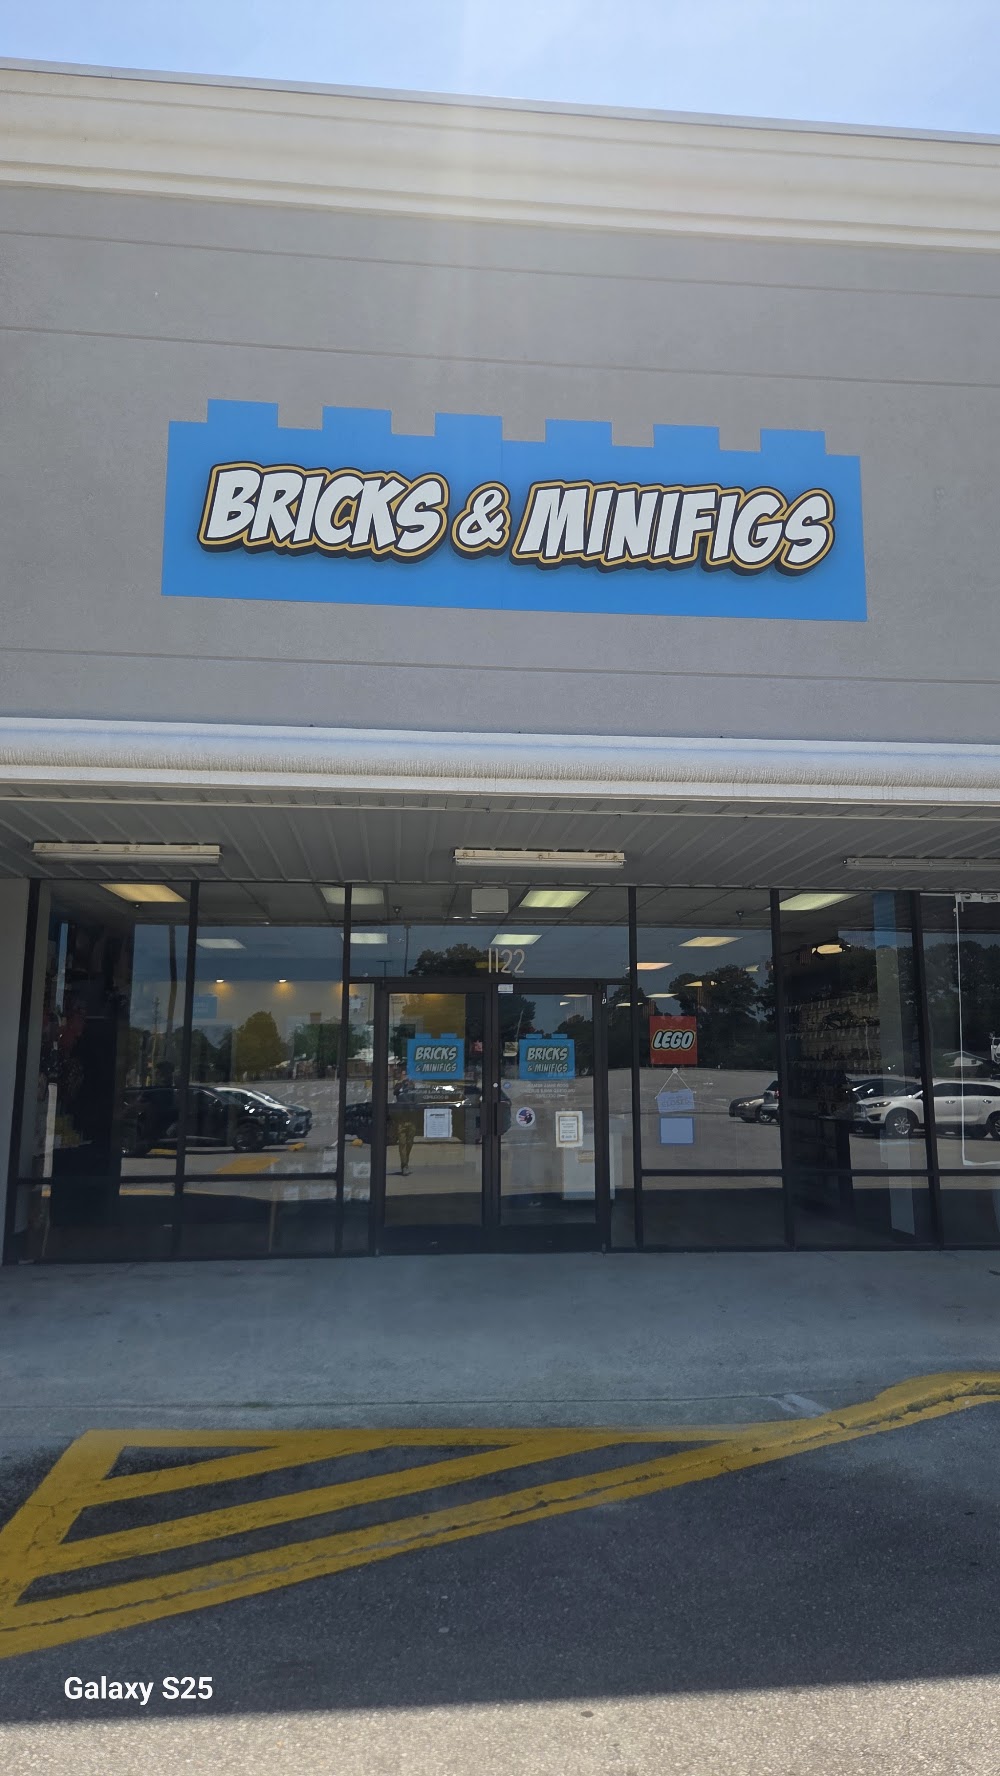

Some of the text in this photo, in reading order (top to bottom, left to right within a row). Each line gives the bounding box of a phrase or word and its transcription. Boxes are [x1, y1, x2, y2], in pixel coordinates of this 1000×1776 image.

[202, 465, 832, 567] BRICKS & MINIFIGS
[488, 948, 525, 973] 1122
[652, 1030, 695, 1050] LEGO
[415, 1046, 457, 1060] BRICKS
[527, 1047, 568, 1060] BRICKS
[415, 1063, 457, 1072] & MINIFIGS
[534, 1063, 568, 1072] MINIFIGS
